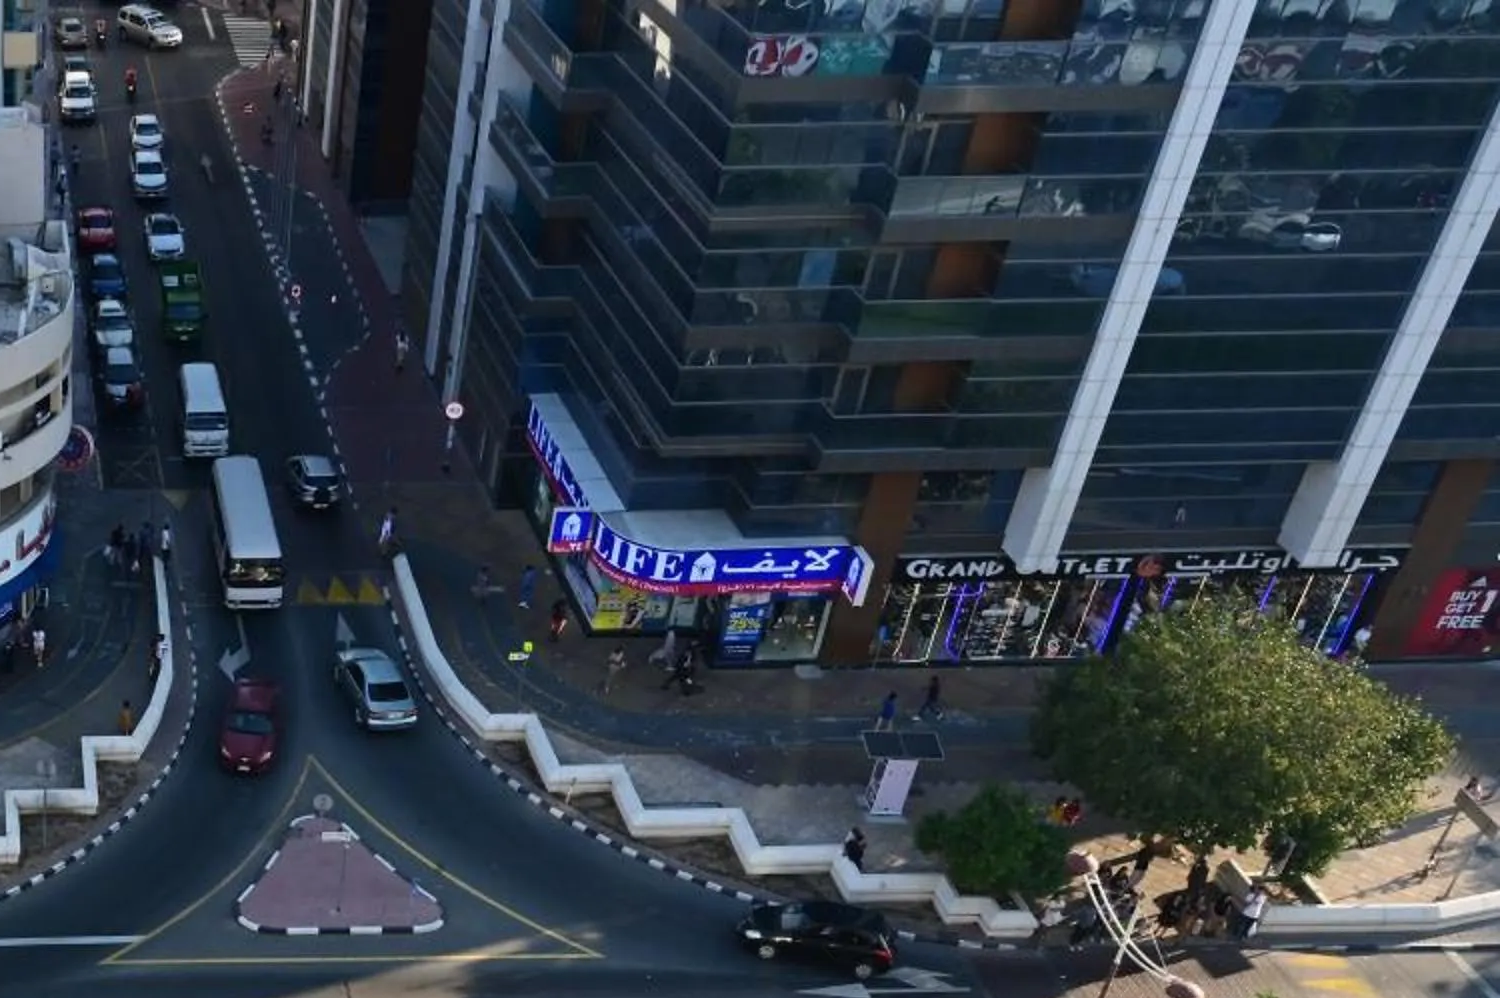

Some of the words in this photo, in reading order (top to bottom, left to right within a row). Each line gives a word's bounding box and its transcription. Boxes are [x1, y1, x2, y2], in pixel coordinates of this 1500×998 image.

[593, 520, 685, 582] LIFE
[722, 548, 840, 579] لايف
[906, 558, 1004, 579] GRAND
[1449, 590, 1482, 602] BUY
[1444, 602, 1476, 614] GET
[1436, 614, 1485, 629] FREE
